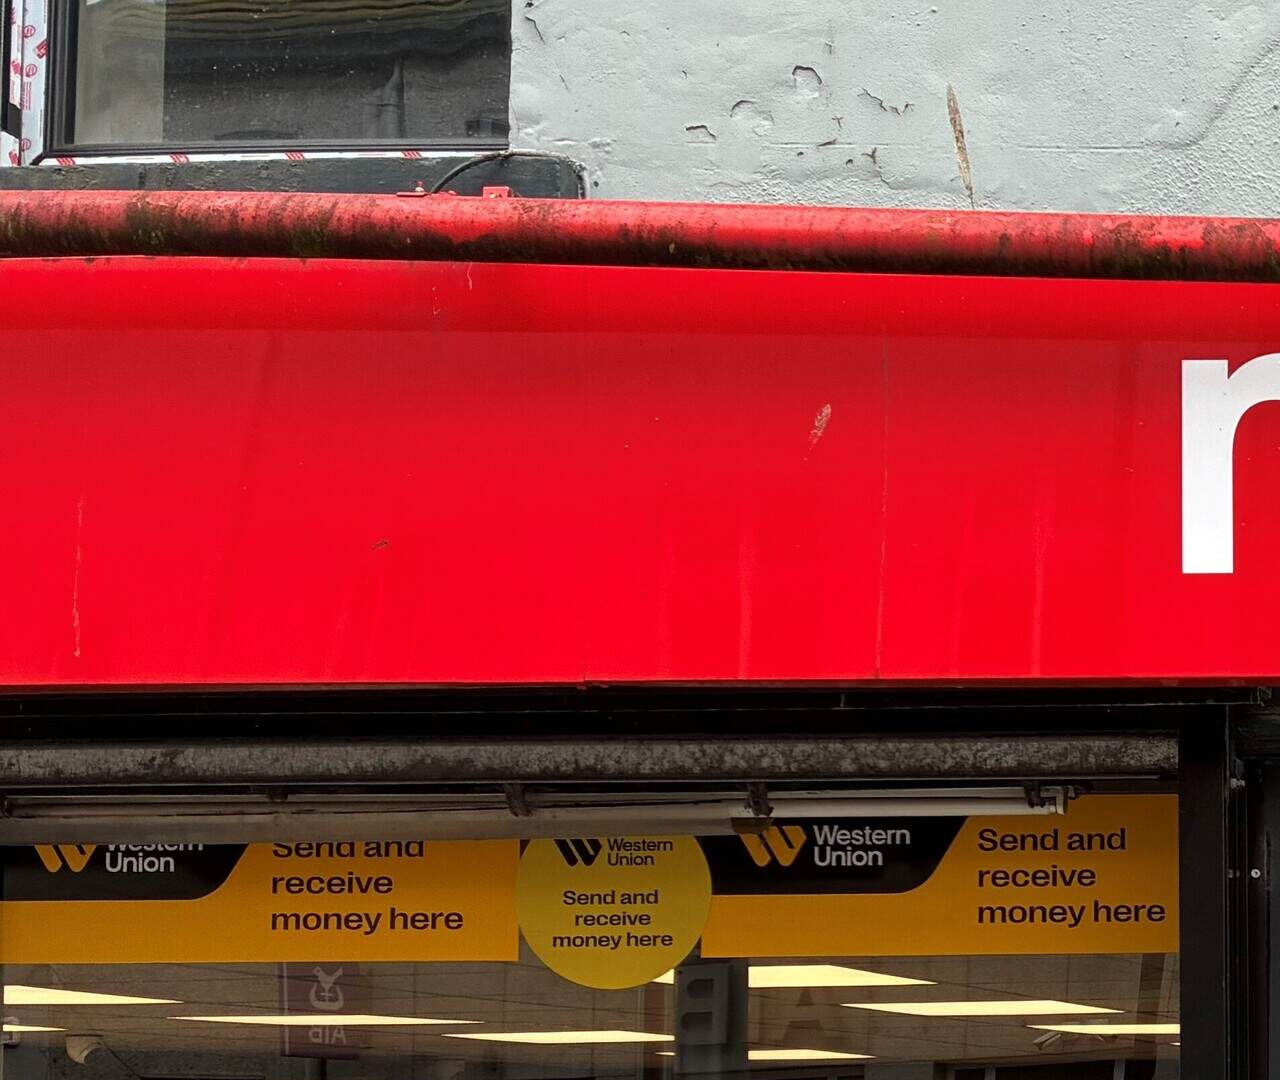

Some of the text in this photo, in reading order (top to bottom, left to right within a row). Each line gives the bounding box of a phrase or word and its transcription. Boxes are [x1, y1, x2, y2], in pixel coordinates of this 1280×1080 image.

[607, 838, 674, 853] Western
[813, 825, 911, 846] Western
[977, 826, 1127, 852] Send and
[272, 841, 425, 859] Send and
[607, 852, 655, 867] Union
[813, 846, 883, 867] Union
[105, 852, 175, 873] Union
[271, 872, 394, 895] receive
[977, 865, 1097, 888] receive
[562, 889, 659, 905] Send and
[271, 907, 464, 936] money here
[574, 911, 651, 926] receive
[977, 899, 1166, 929] money here
[551, 932, 673, 951] money here
